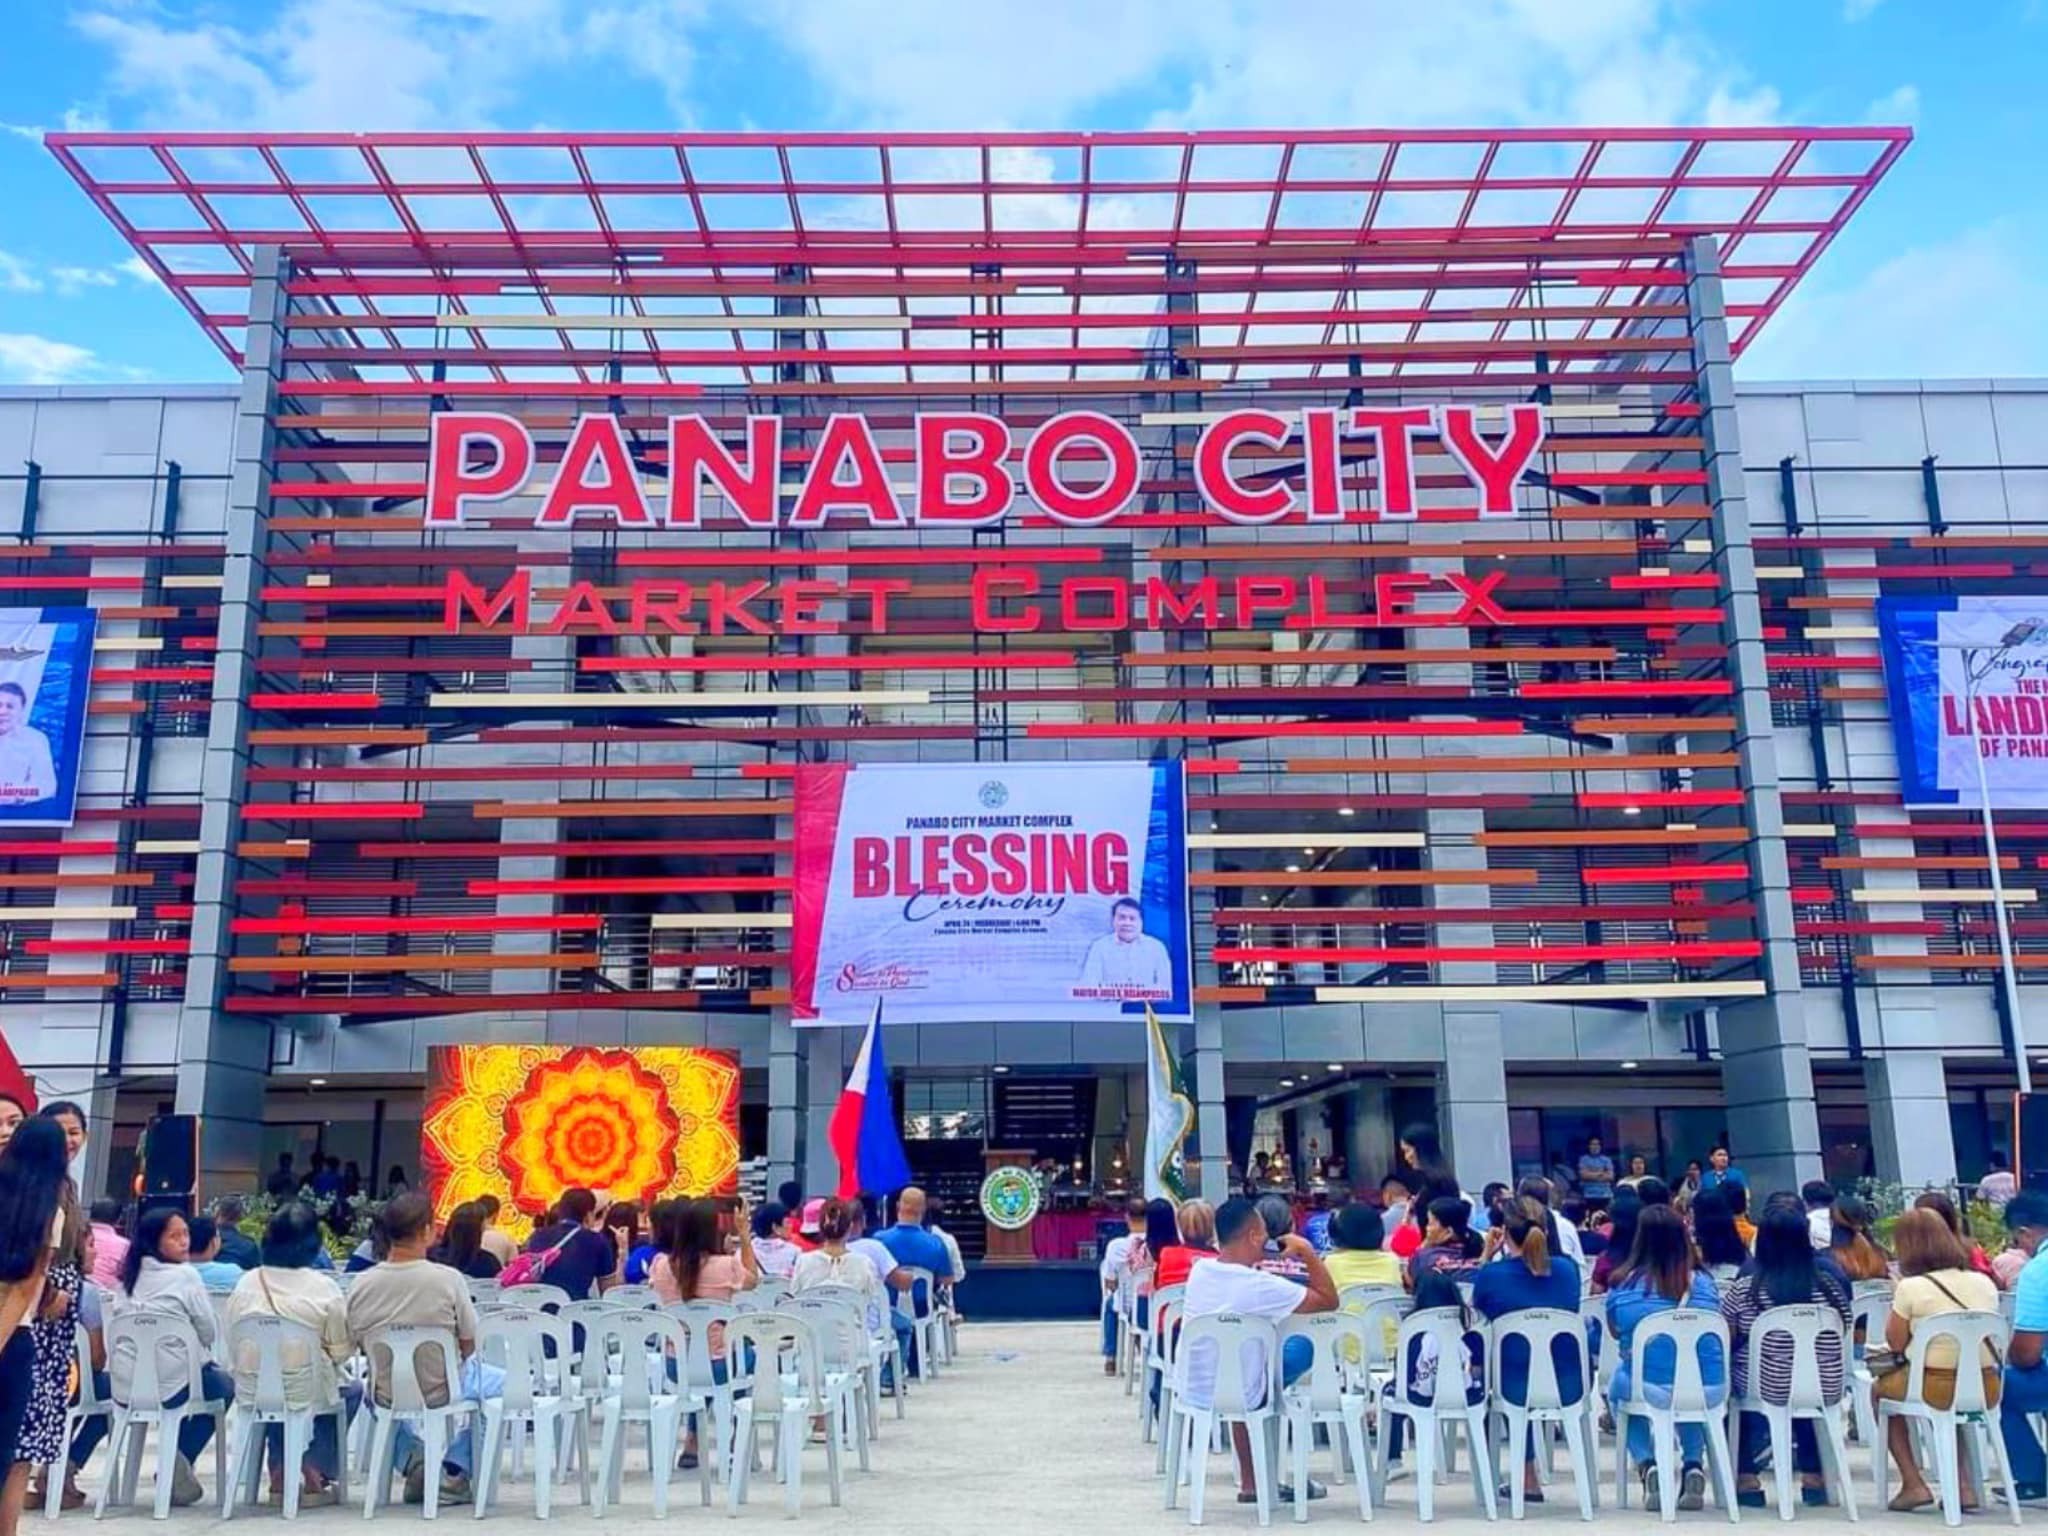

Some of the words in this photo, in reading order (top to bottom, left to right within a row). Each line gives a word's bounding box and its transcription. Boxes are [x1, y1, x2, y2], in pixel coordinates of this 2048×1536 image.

[424, 410, 1142, 527] PANABO
[1193, 403, 1545, 525] CITY
[2015, 679, 2041, 694] THE
[1943, 695, 2048, 736] LAND
[1980, 738, 2000, 758] OF
[2007, 738, 2048, 758] PAN
[906, 816, 949, 829] PANABO
[951, 815, 977, 829] CITY
[978, 815, 1021, 828] MARKET
[1023, 814, 1073, 828] COMPLEX
[853, 832, 1129, 898] BLESSING
[902, 885, 1065, 922] Ceremony
